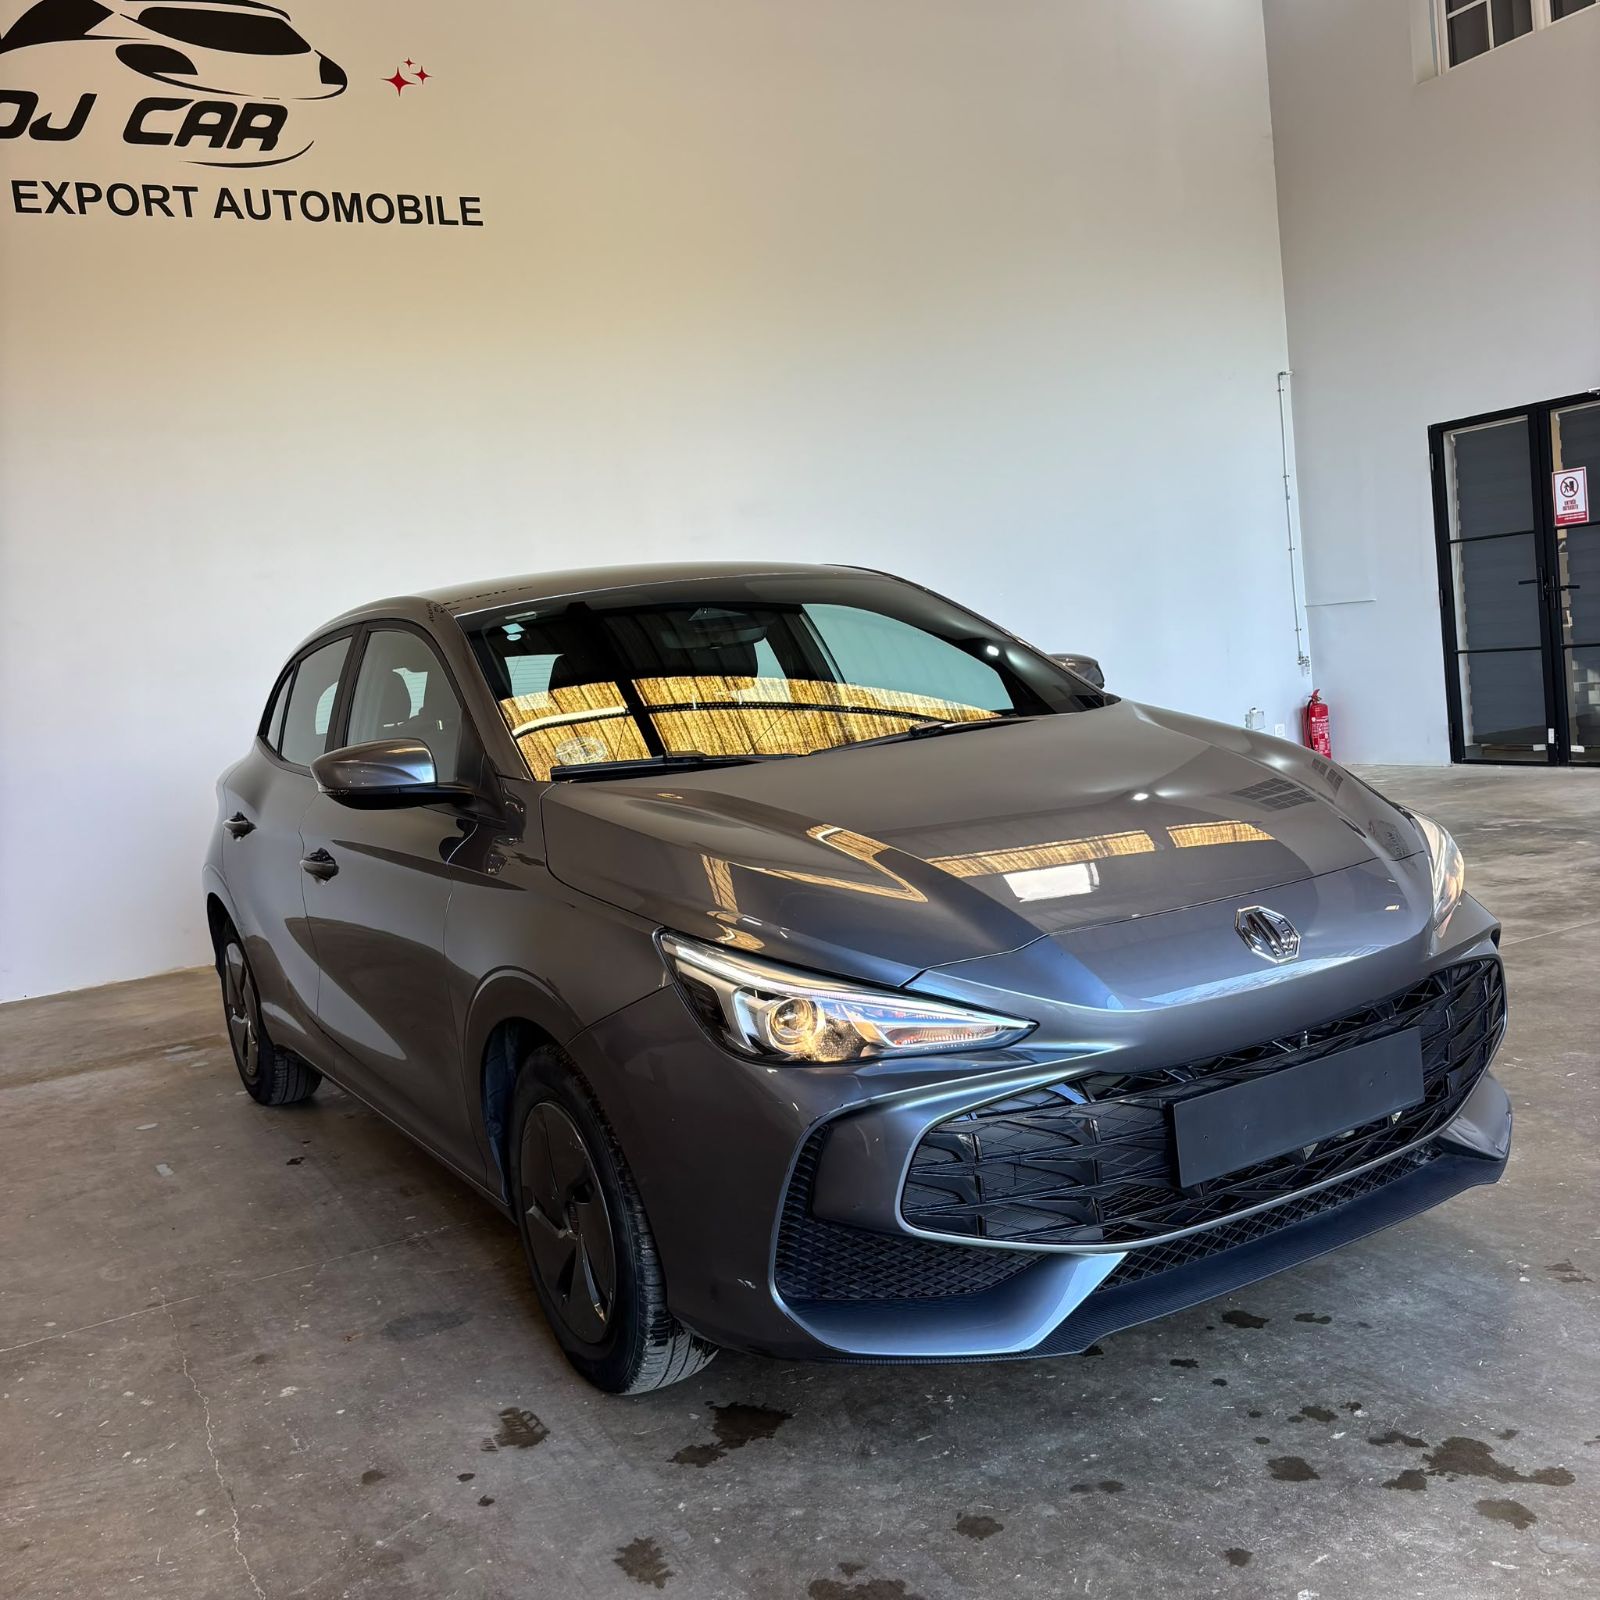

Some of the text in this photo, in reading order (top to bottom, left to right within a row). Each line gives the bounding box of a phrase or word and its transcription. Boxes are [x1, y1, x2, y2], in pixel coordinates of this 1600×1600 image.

[123, 98, 288, 151] CAR
[11, 180, 484, 226] EXPORT AUTOMOBILE
[1237, 908, 1299, 961] MG
